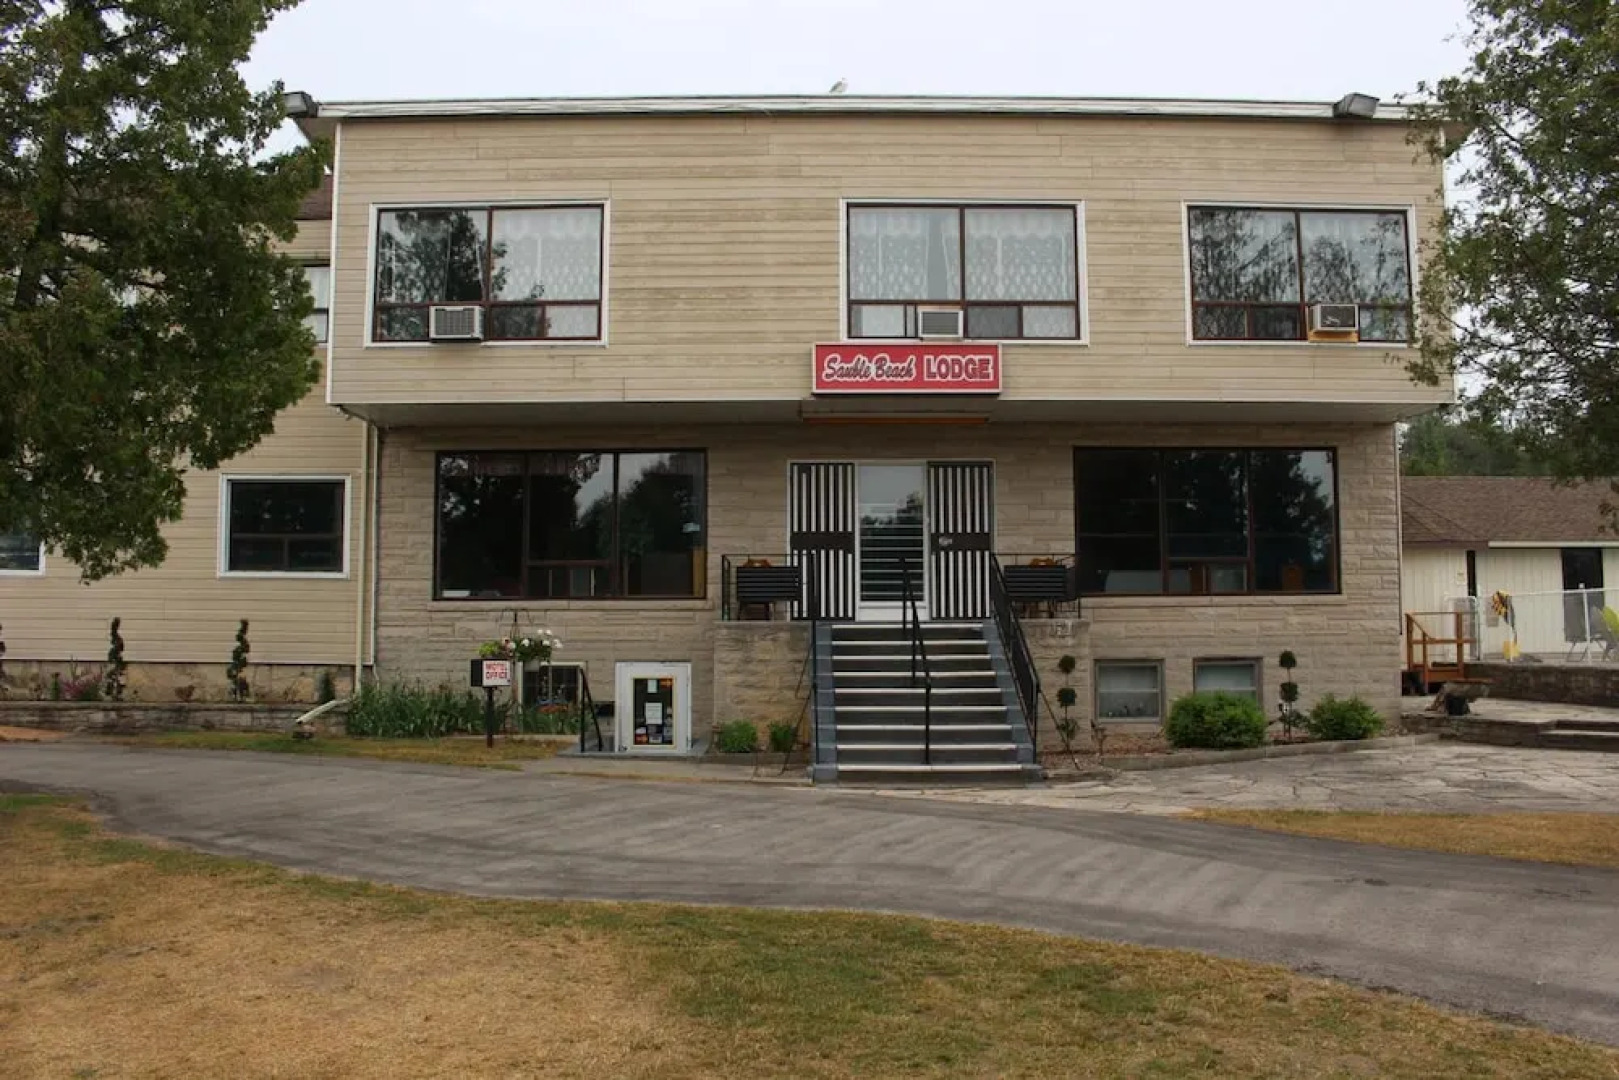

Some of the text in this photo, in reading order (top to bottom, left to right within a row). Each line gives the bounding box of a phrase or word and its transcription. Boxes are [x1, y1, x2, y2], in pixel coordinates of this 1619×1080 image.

[823, 353, 994, 381] Sauble Beach LODGE
